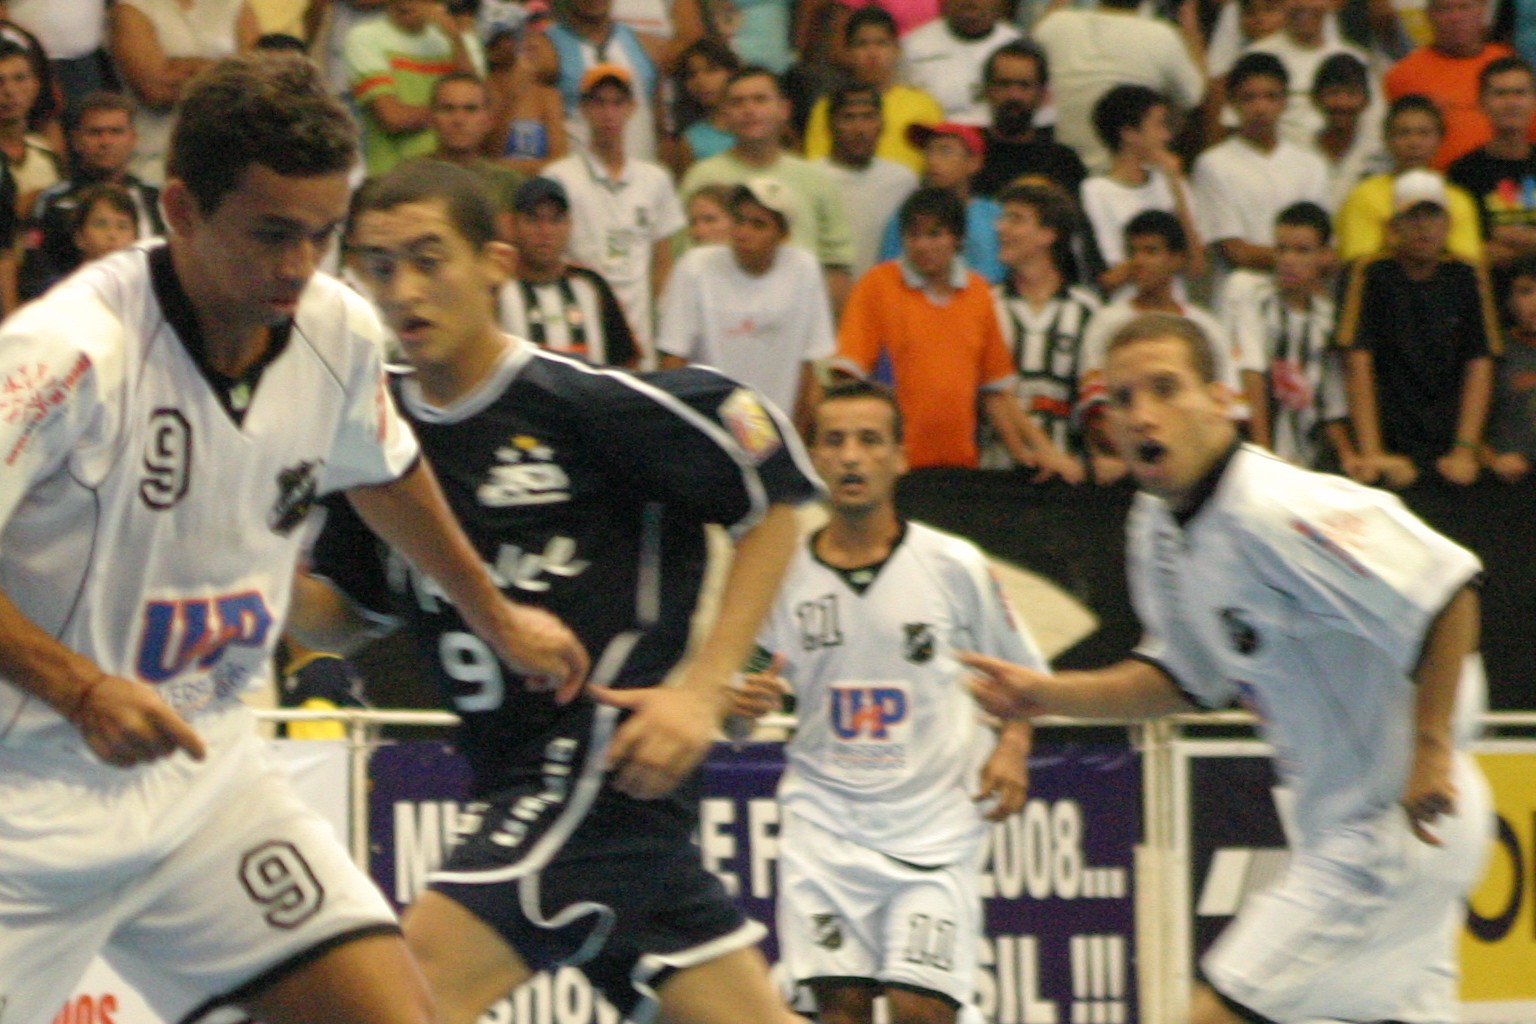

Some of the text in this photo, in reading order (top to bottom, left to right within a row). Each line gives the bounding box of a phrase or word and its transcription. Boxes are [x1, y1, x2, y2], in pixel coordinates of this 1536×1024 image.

[140, 408, 193, 511] 9
[438, 631, 507, 713] 9
[239, 840, 325, 929] 9
